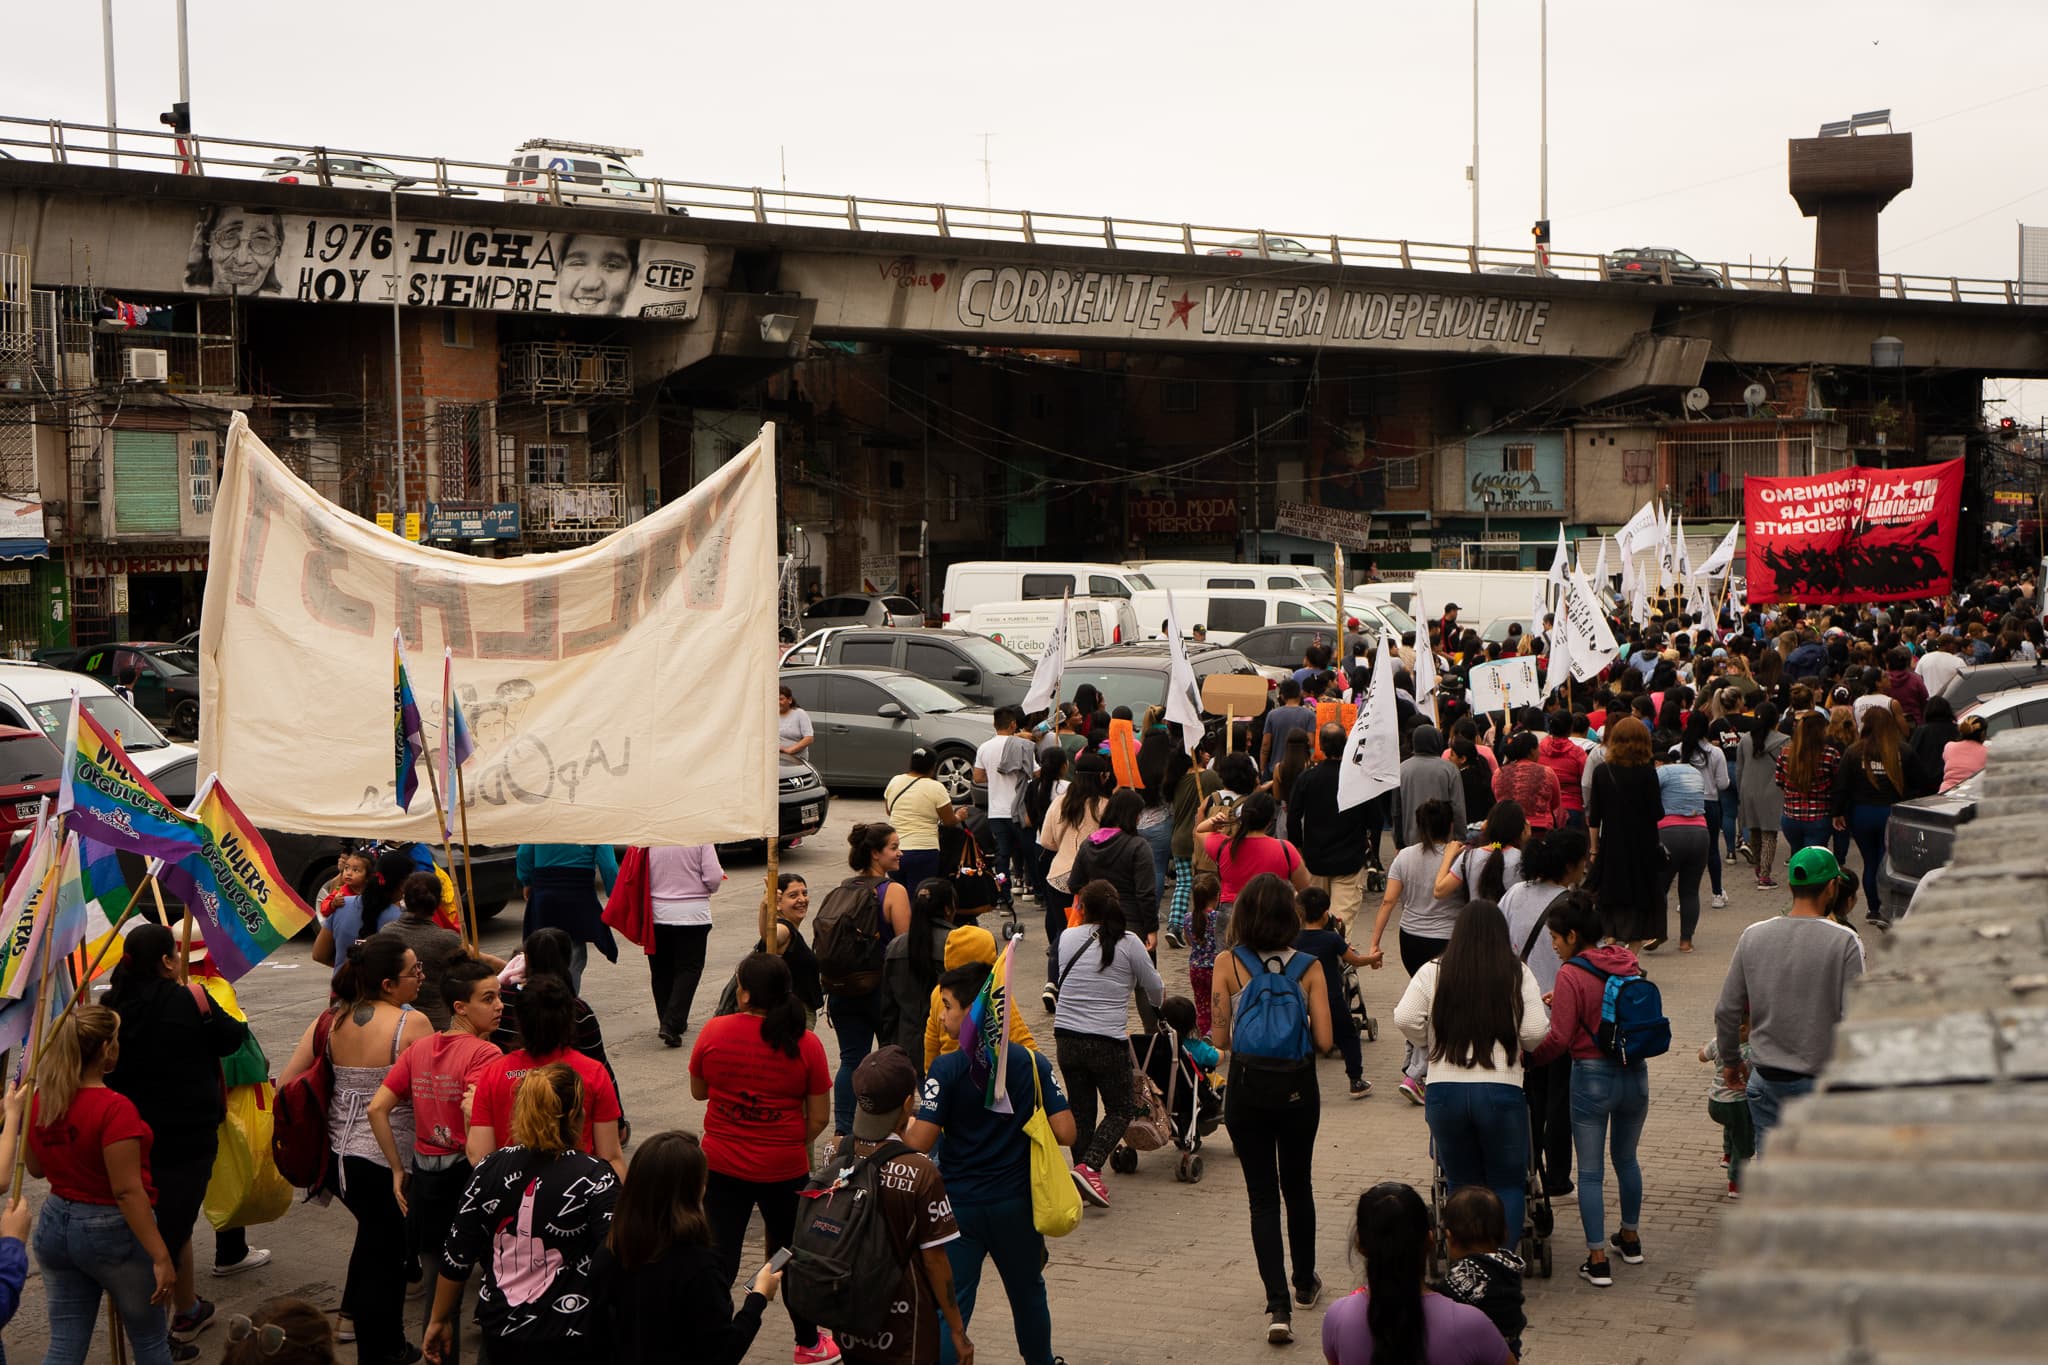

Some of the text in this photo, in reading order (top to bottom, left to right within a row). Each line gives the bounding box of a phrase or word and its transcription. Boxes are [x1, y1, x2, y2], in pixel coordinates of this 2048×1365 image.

[304, 222, 392, 262] 1976
[300, 267, 370, 301] HOY
[407, 273, 558, 313] SIEMPRE
[646, 265, 694, 287] CTEP
[1471, 471, 1551, 502] Gracias
[1129, 498, 1237, 517] TODO MODA
[85, 556, 208, 576] TORETT
[1018, 640, 1045, 650] Ceibo
[78, 762, 180, 825] ORGULLOSAS
[219, 831, 272, 905] VILLERAS
[200, 841, 265, 935] ORGULLOSAS
